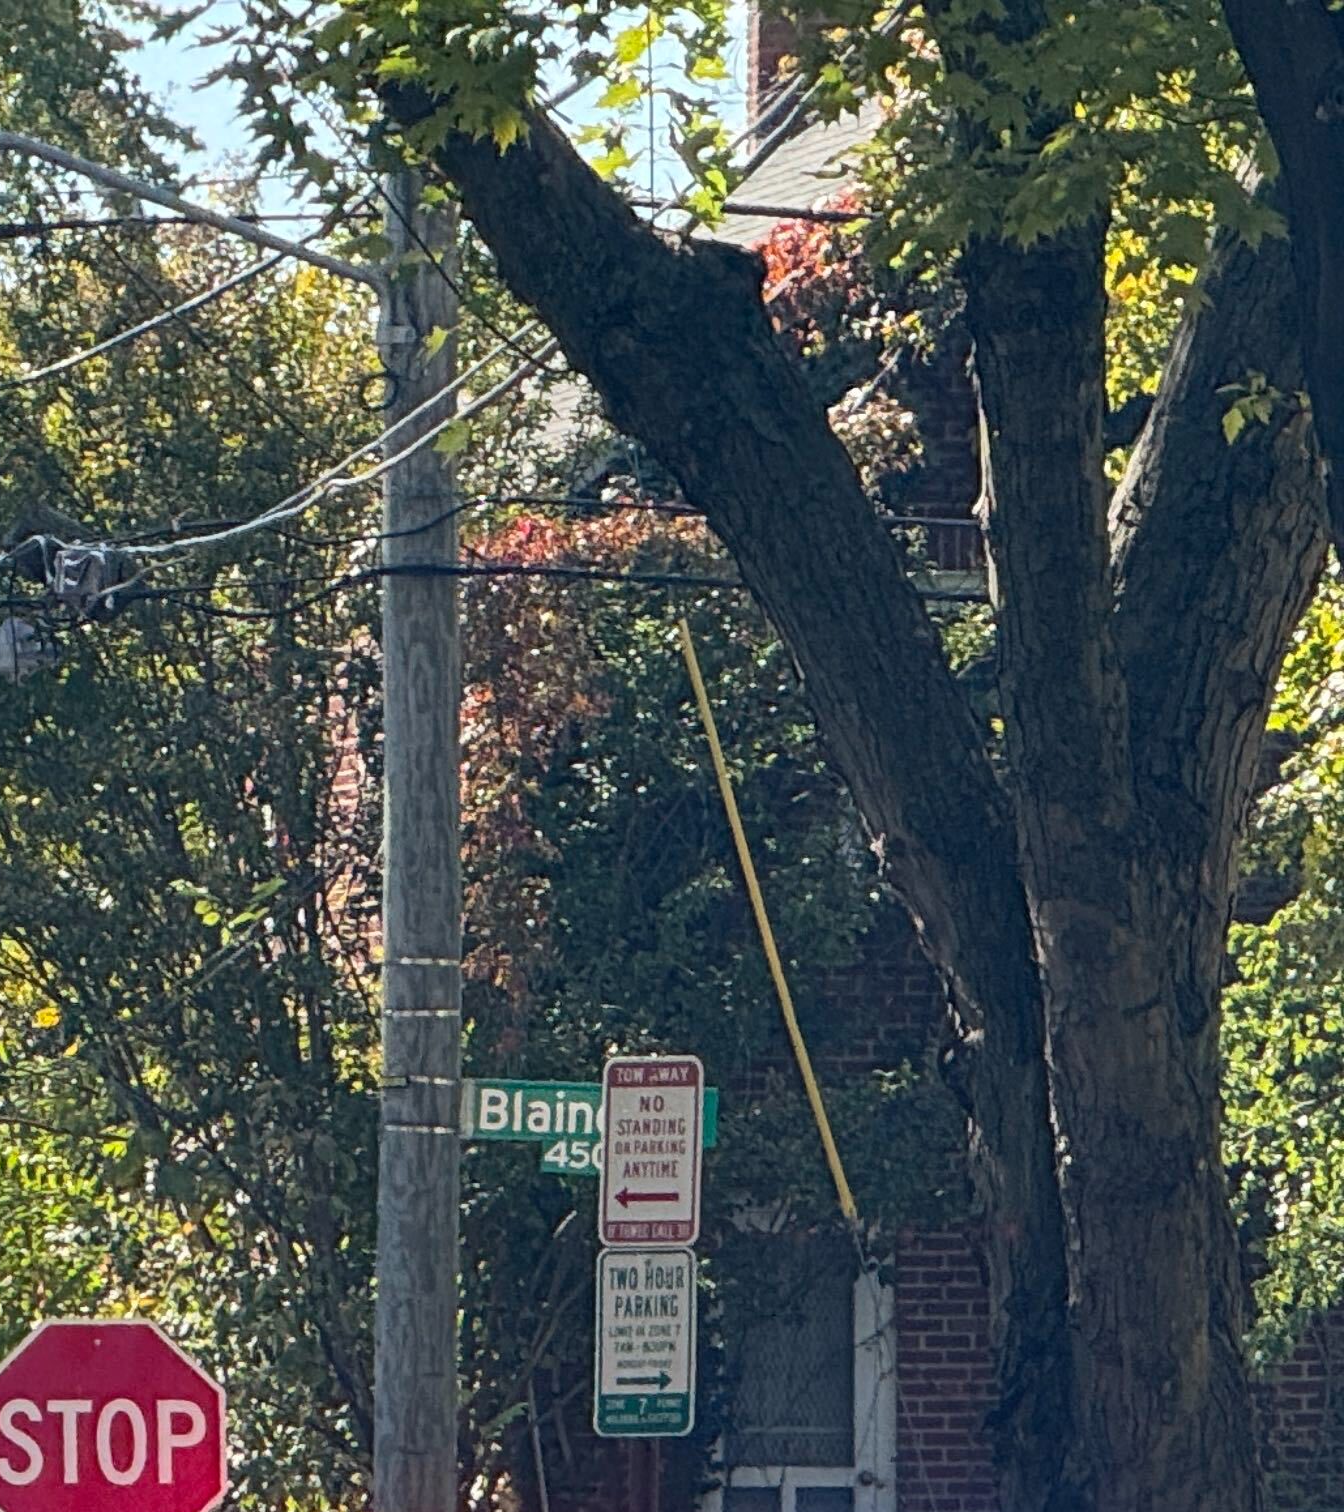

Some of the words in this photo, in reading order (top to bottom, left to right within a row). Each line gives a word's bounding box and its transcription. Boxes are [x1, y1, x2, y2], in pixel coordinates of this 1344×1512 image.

[615, 1067, 644, 1083] TOW
[649, 1067, 689, 1082] AWAY
[639, 1095, 665, 1113] NO
[617, 1118, 687, 1136] STANDING
[615, 1141, 634, 1155] OR
[634, 1140, 686, 1155] PARKING
[623, 1160, 679, 1179] ANYTIME
[609, 1266, 639, 1291] TWO
[644, 1265, 685, 1290] HOUR
[615, 1294, 679, 1318] PARKING
